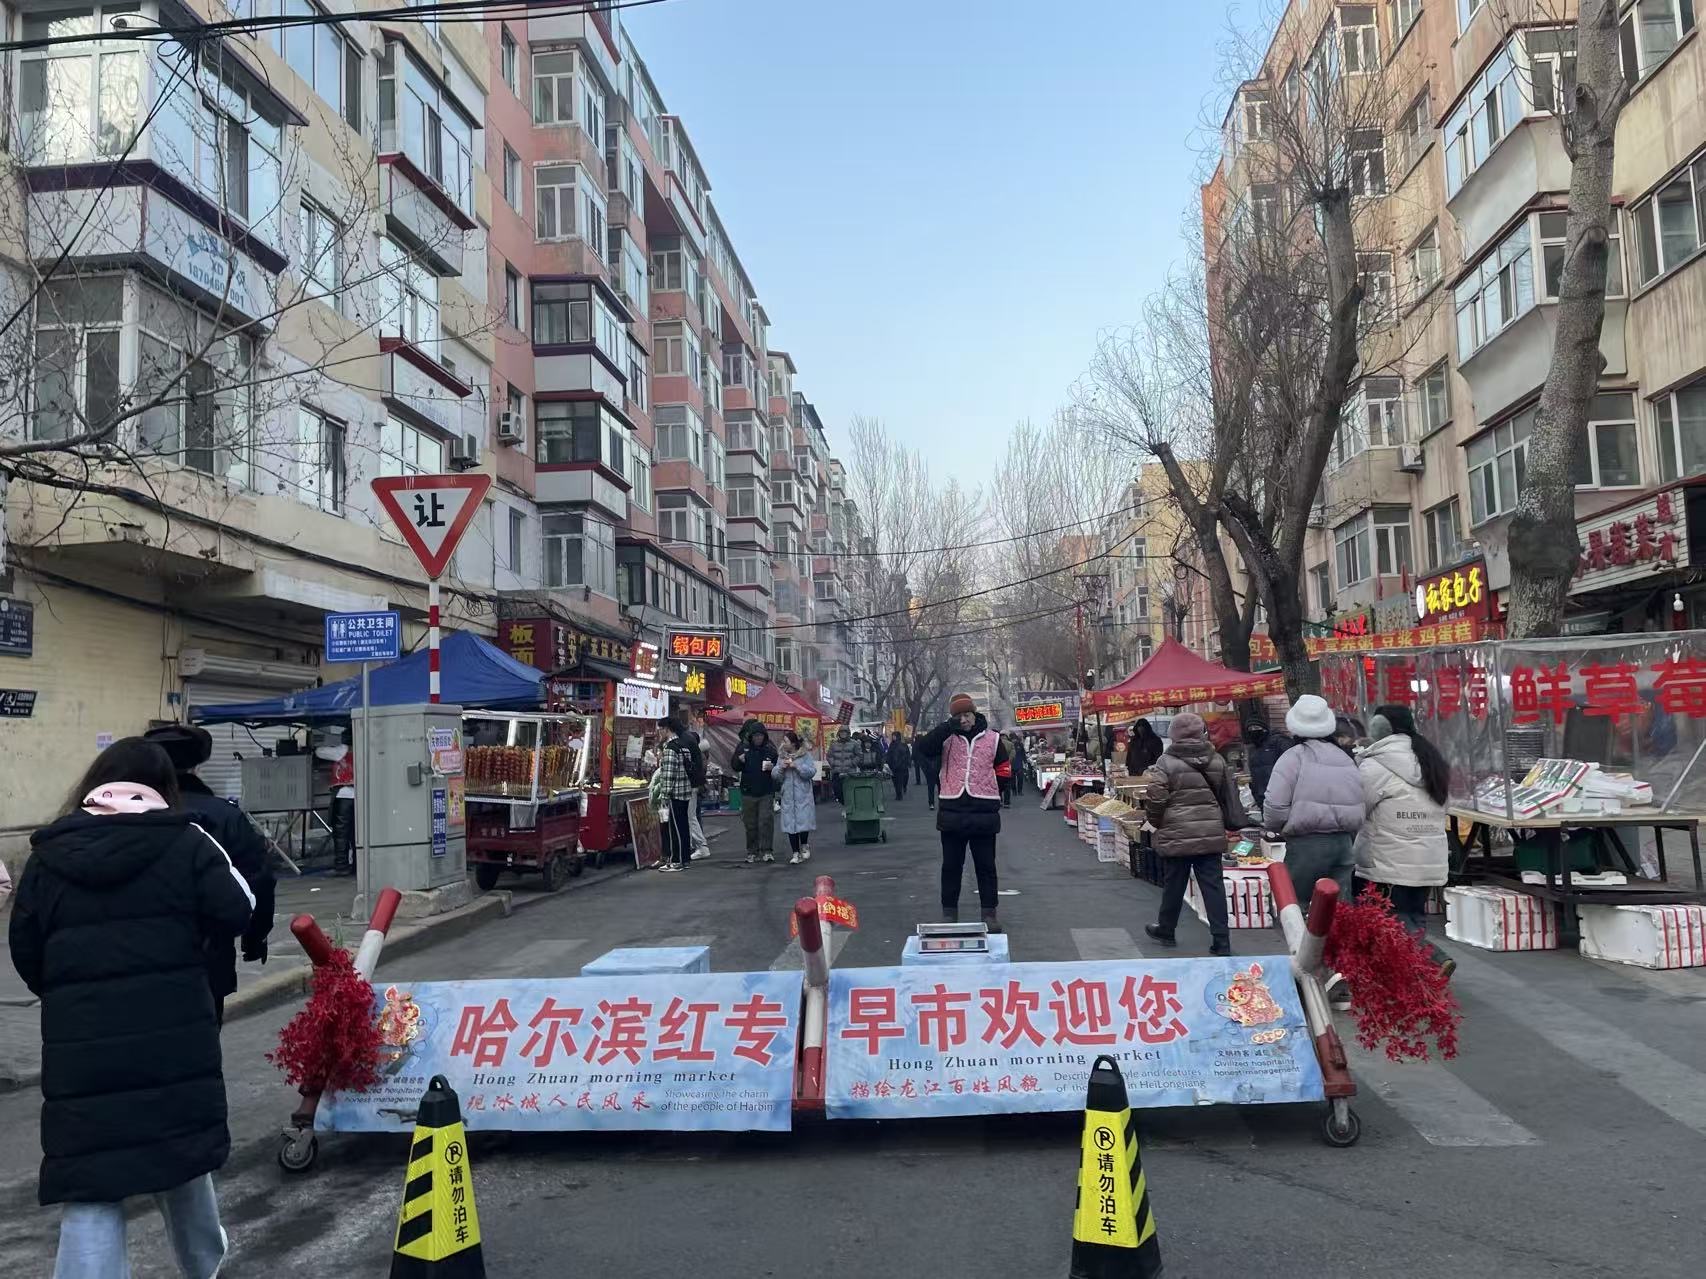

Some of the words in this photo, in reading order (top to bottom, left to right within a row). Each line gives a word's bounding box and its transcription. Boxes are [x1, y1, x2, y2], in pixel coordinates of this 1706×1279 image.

[413, 492, 446, 528] 让
[347, 616, 394, 629] 公共卫生间
[348, 630, 370, 638] PUBLIC
[372, 629, 393, 637] TOILET
[1325, 637, 1374, 653] 营养粥
[1381, 629, 1413, 648] 豆浆
[1419, 621, 1472, 646] 鸡蛋糕
[672, 635, 721, 657] 锅包肉
[1509, 657, 1706, 726] 鲜草莓
[841, 974, 1190, 1056] 早市欢迎您
[449, 992, 790, 1069] 哈尔滨红专
[889, 1058, 935, 1072] Hong
[945, 1056, 999, 1069] Zhuan
[1010, 1052, 1086, 1067] morning
[1214, 1059, 1249, 1067] Civilized
[1251, 1057, 1296, 1067] hospitality
[473, 1073, 516, 1086] Hong
[527, 1072, 579, 1085] Zhuan
[590, 1071, 663, 1085] morning
[673, 1069, 737, 1083] market
[1141, 1068, 1160, 1078] and
[1161, 1066, 1202, 1077] features
[1213, 1069, 1243, 1077] honest
[1245, 1066, 1301, 1075] management
[384, 1087, 424, 1095] hospitality
[664, 1089, 720, 1100] Showcasing
[722, 1088, 736, 1098] the
[738, 1088, 769, 1098] charm
[850, 1074, 1043, 1100] 描绘龙江百姓风貌
[1055, 1084, 1067, 1093] of
[1071, 1083, 1088, 1092] the
[660, 1101, 674, 1111] of
[674, 1101, 689, 1111] the
[690, 1102, 725, 1113] people
[726, 1101, 739, 1111] of
[740, 1101, 774, 1111] Harbin
[1097, 1152, 1117, 1237] 请勿泊车
[448, 1165, 470, 1245] 请勿泊车
